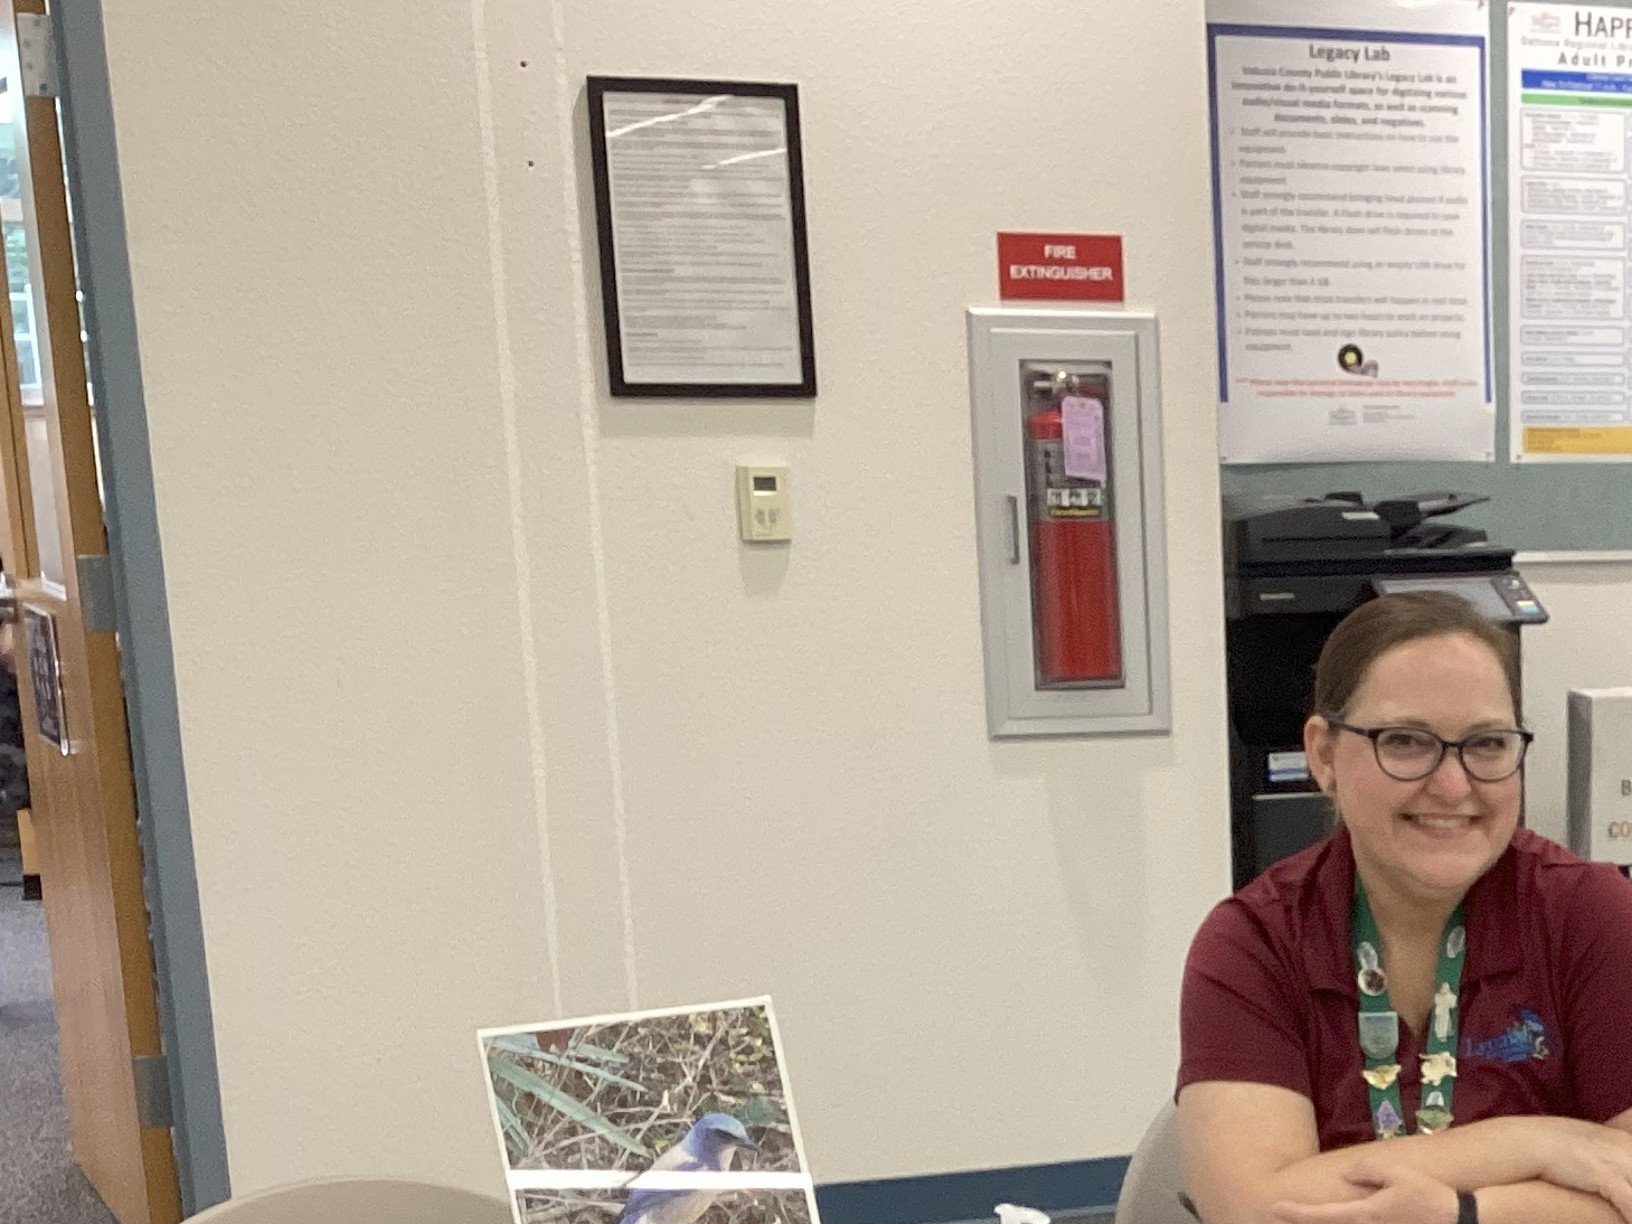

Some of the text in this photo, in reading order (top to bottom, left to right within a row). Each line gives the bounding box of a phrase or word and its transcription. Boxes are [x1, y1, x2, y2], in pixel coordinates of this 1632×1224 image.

[1309, 44, 1390, 63] Legacy Lab
[1557, 51, 1607, 67] Adult
[1044, 244, 1076, 259] FIRE
[1010, 264, 1113, 281] EXTINGUISHER
